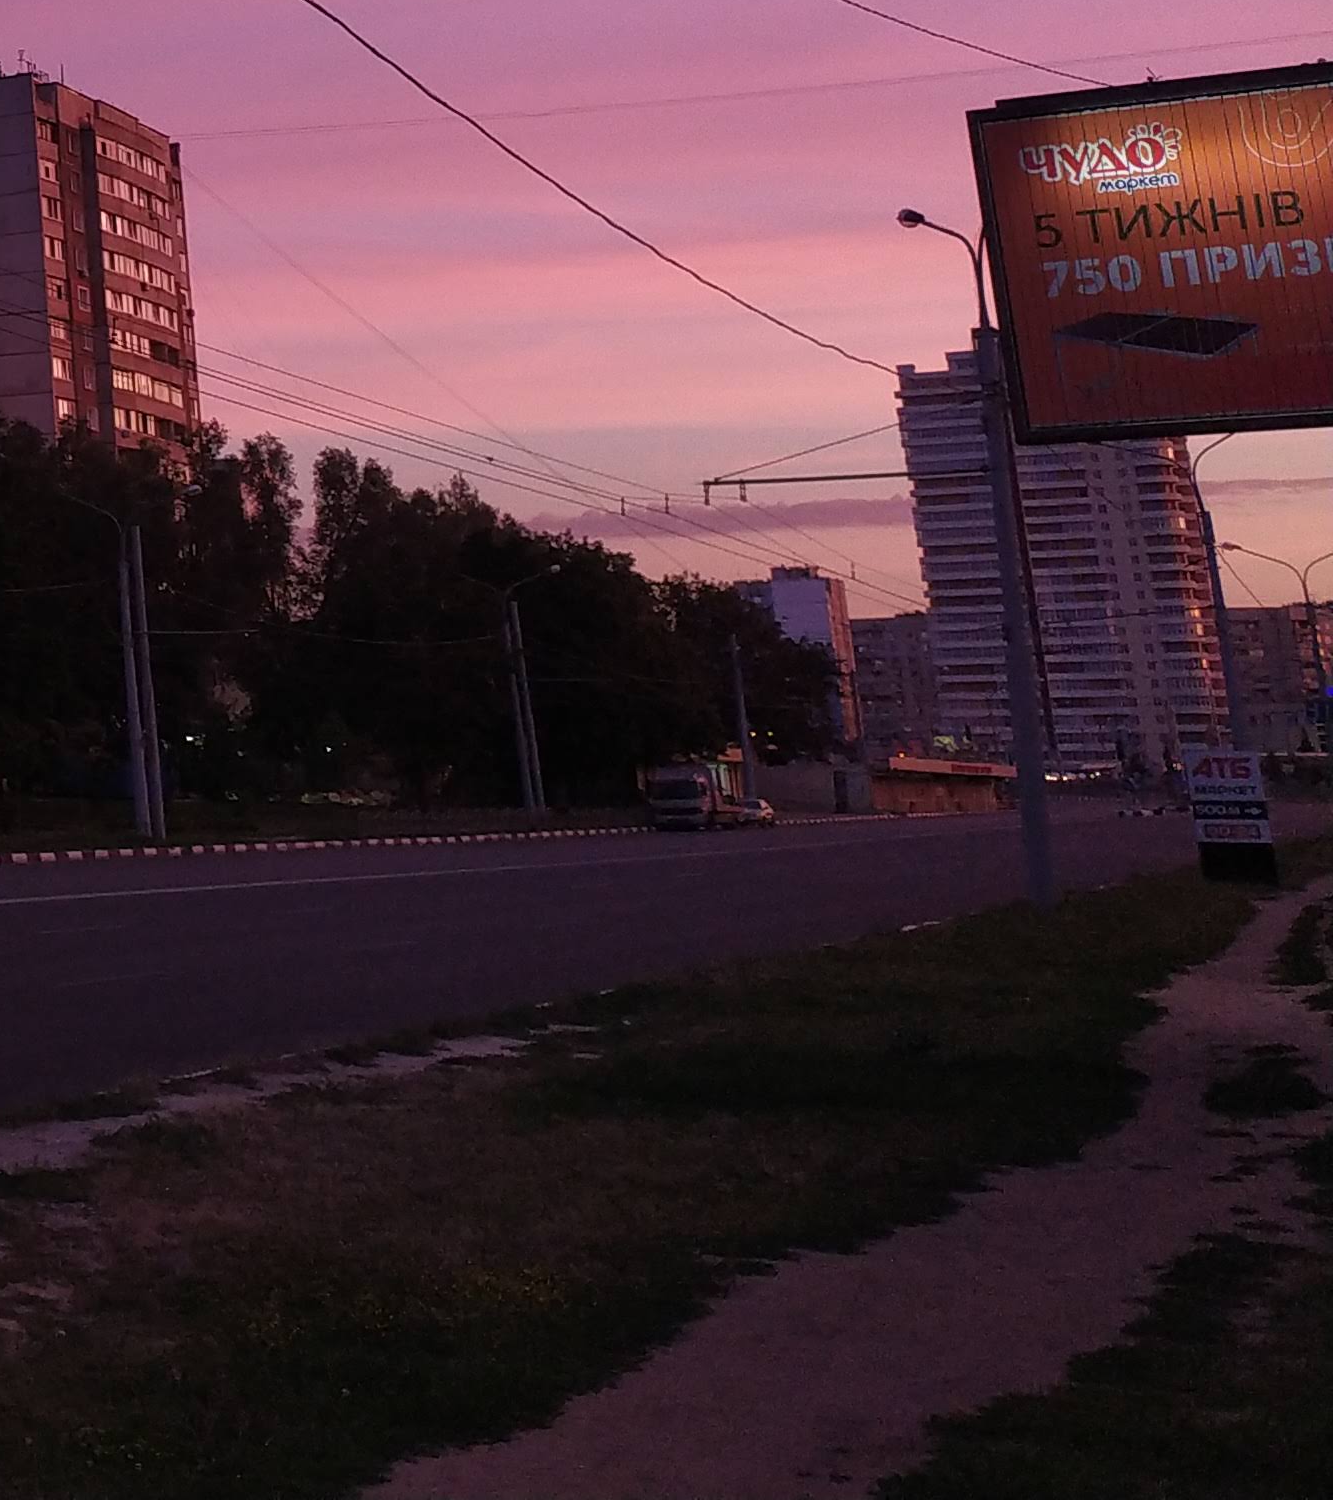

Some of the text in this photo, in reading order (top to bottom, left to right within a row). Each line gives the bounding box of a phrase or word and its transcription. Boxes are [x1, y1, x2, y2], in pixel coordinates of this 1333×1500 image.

[1019, 128, 1174, 185] ЧУДО
[1098, 172, 1179, 194] маркет
[1034, 190, 1304, 248] 5 ТИЖНІВ
[1041, 255, 1142, 299] 750
[1192, 756, 1251, 779] АТБ
[1194, 785, 1257, 795] МАРКЕТ
